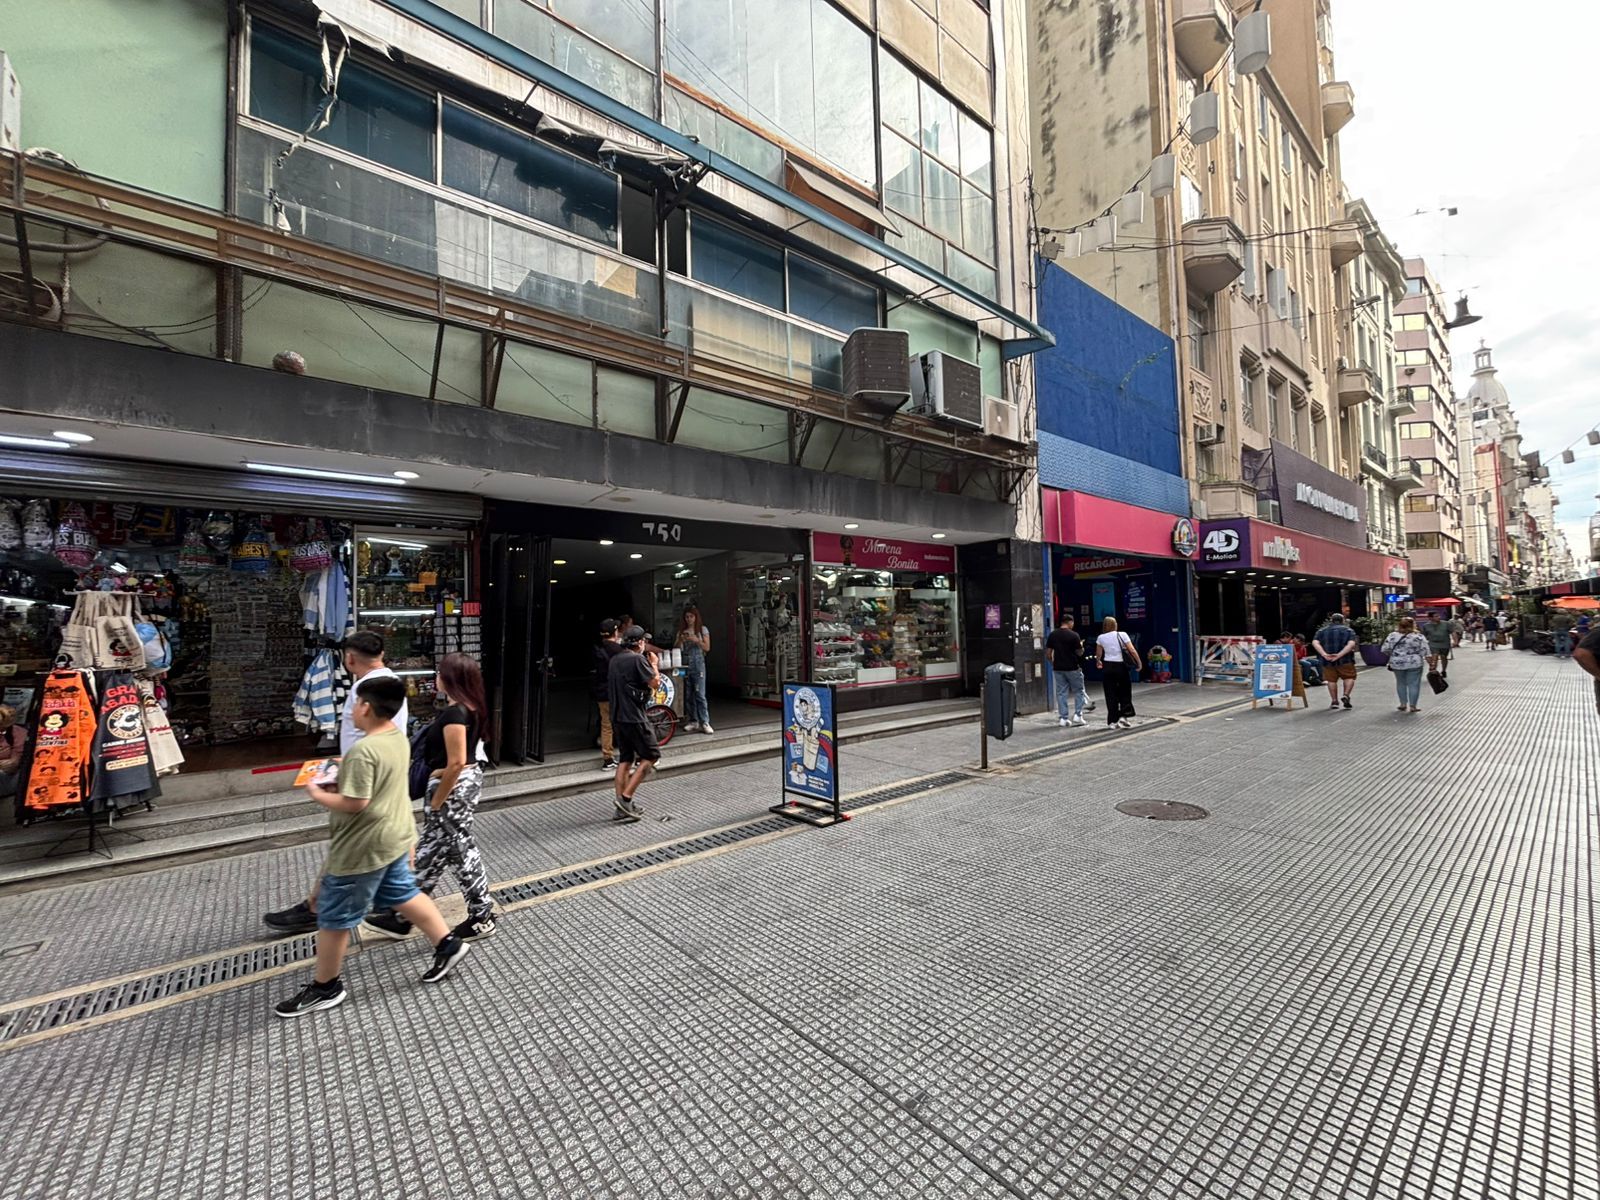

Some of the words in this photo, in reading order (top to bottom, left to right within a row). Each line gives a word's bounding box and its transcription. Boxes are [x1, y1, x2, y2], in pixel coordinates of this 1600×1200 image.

[642, 522, 682, 542] 750
[862, 539, 902, 555] Morena
[1203, 529, 1240, 553] 4D
[886, 555, 920, 569] Bonita
[1206, 553, 1238, 561] E-Motion
